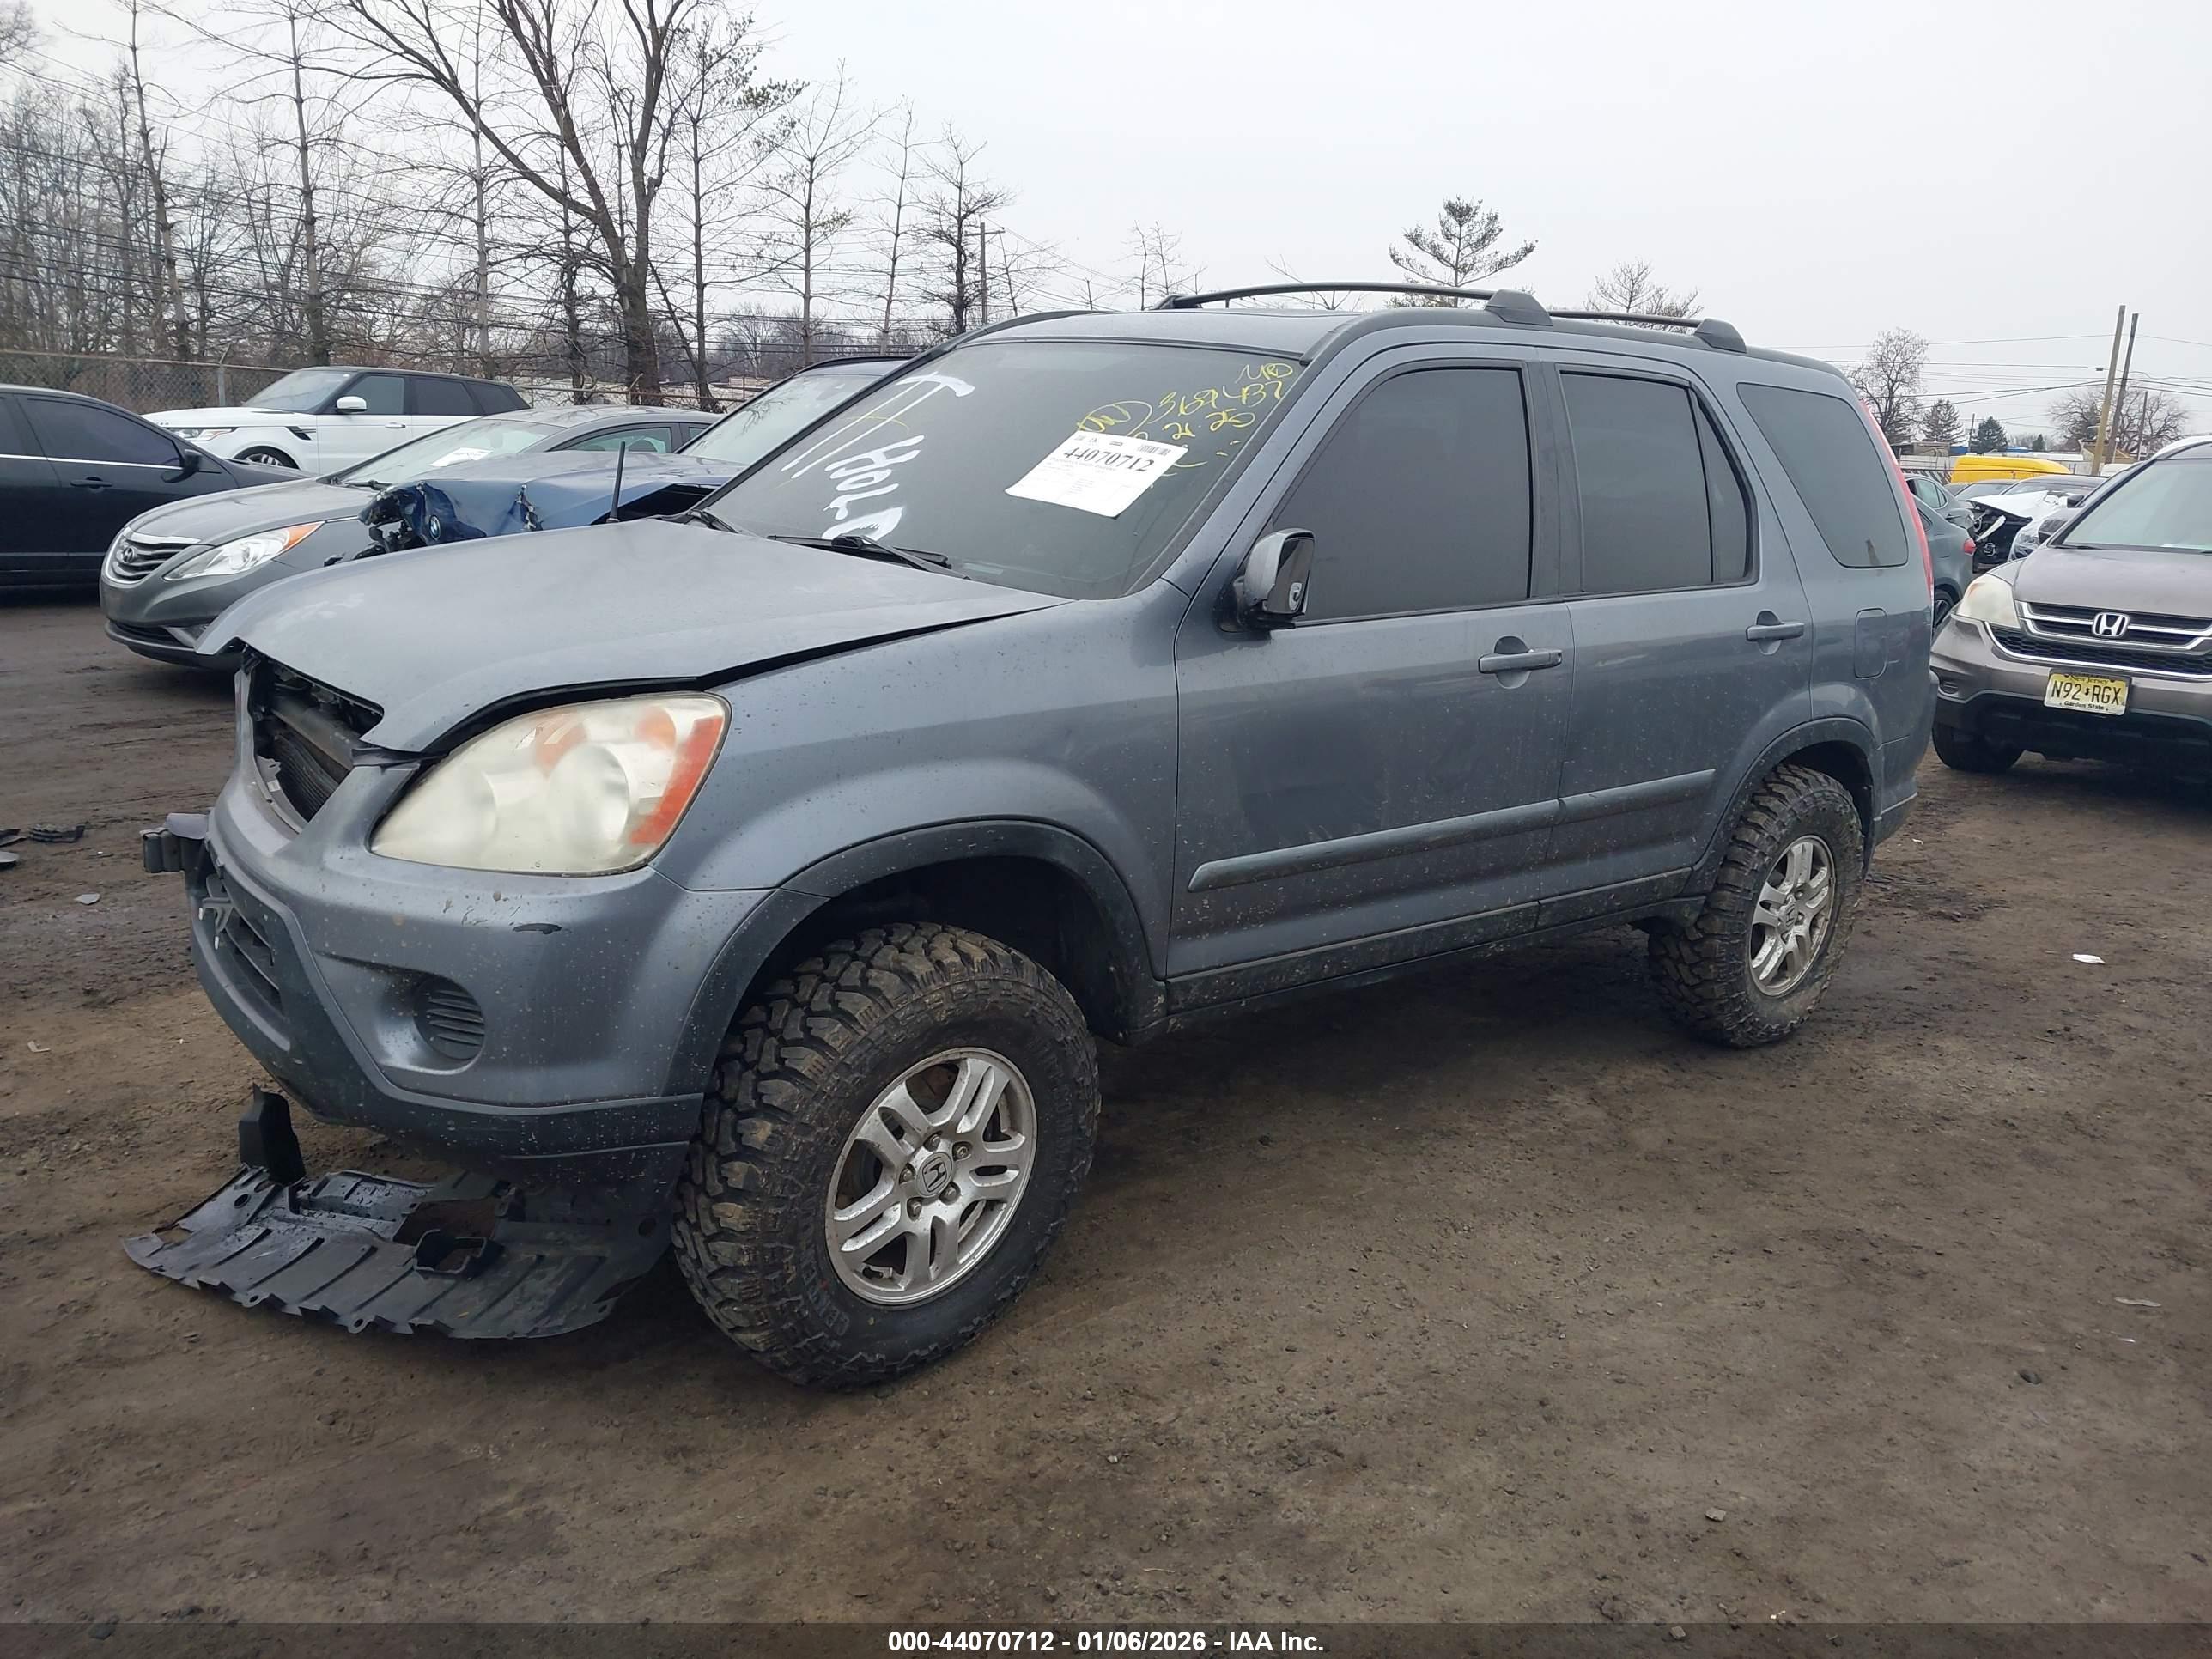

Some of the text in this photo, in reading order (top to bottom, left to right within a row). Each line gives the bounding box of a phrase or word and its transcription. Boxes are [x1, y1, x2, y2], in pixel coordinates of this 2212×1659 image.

[1063, 447, 1155, 472] 44070712
[2051, 680, 2121, 705] N92 RGX
[2087, 676, 2109, 684] Jersey
